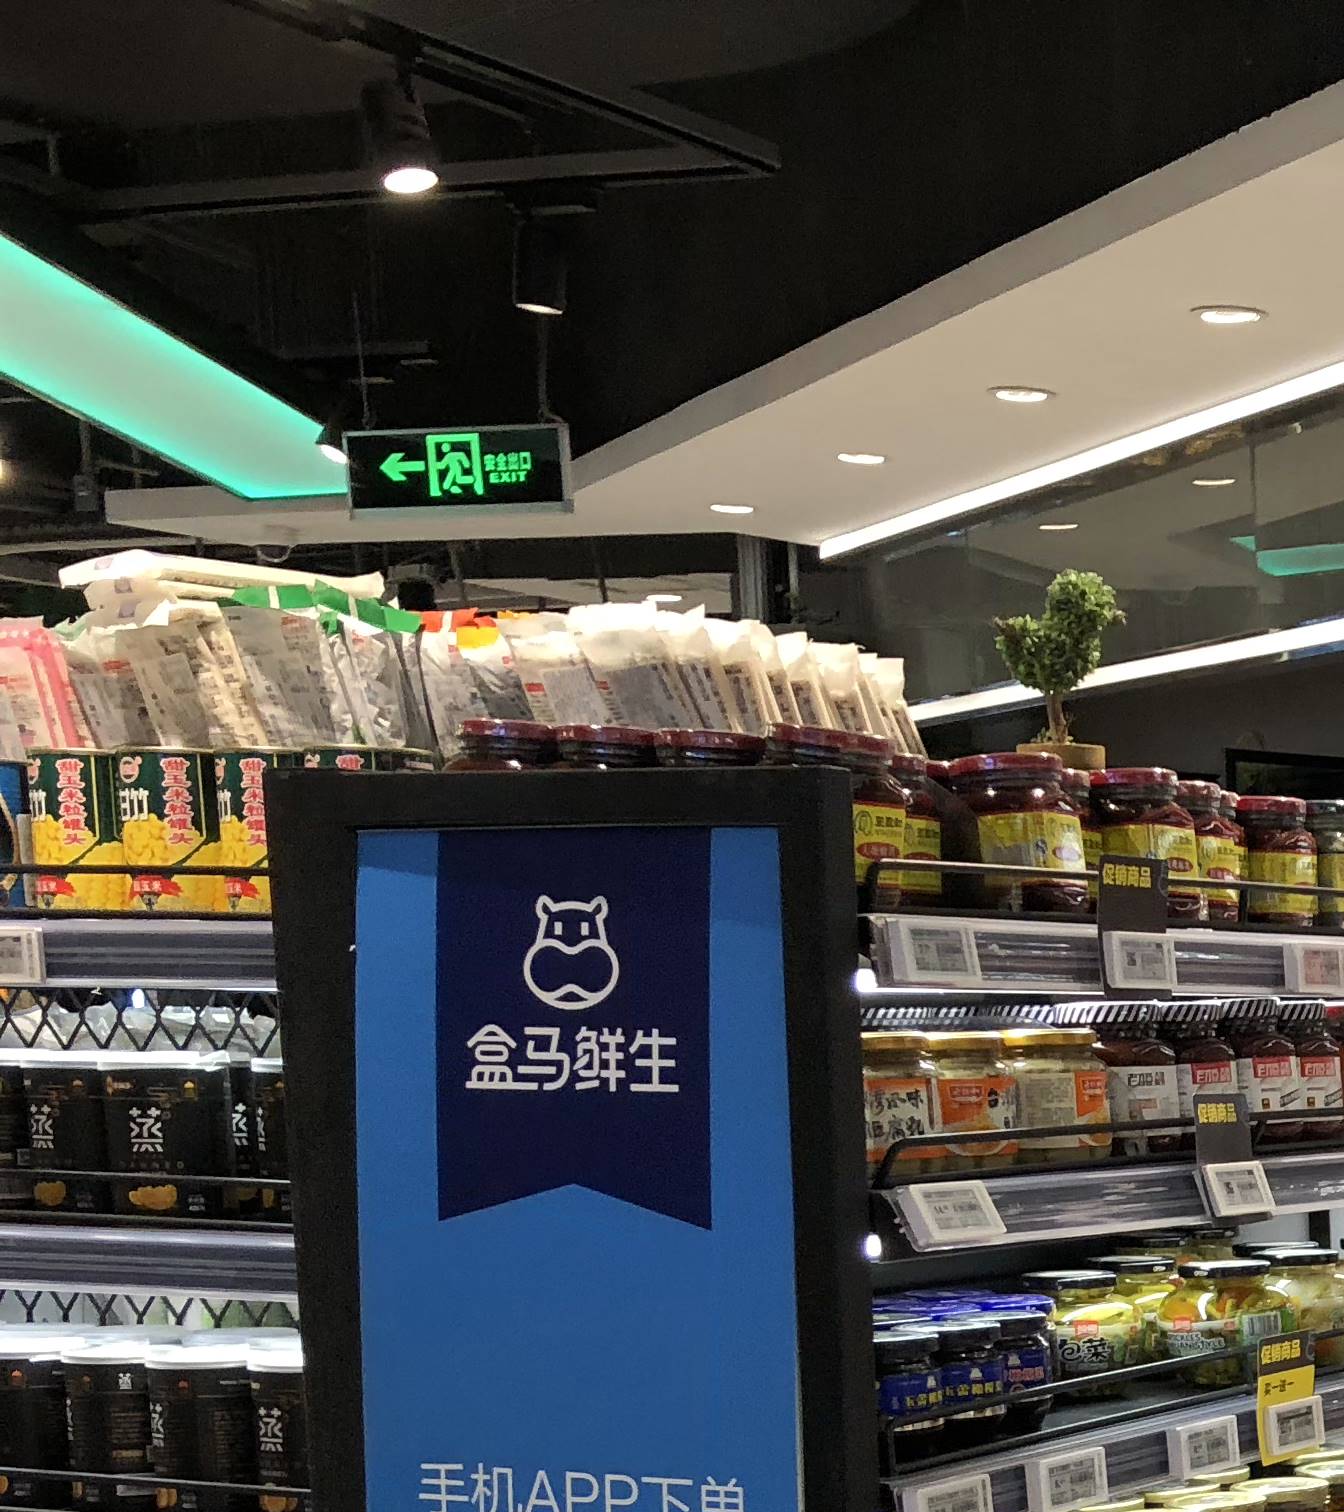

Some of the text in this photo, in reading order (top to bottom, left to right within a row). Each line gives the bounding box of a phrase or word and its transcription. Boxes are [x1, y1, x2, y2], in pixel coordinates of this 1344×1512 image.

[484, 451, 532, 471] 安全出口
[489, 471, 528, 484] EXIT
[1103, 863, 1152, 888] 促销商品
[466, 1025, 680, 1093] 盒马鲜生
